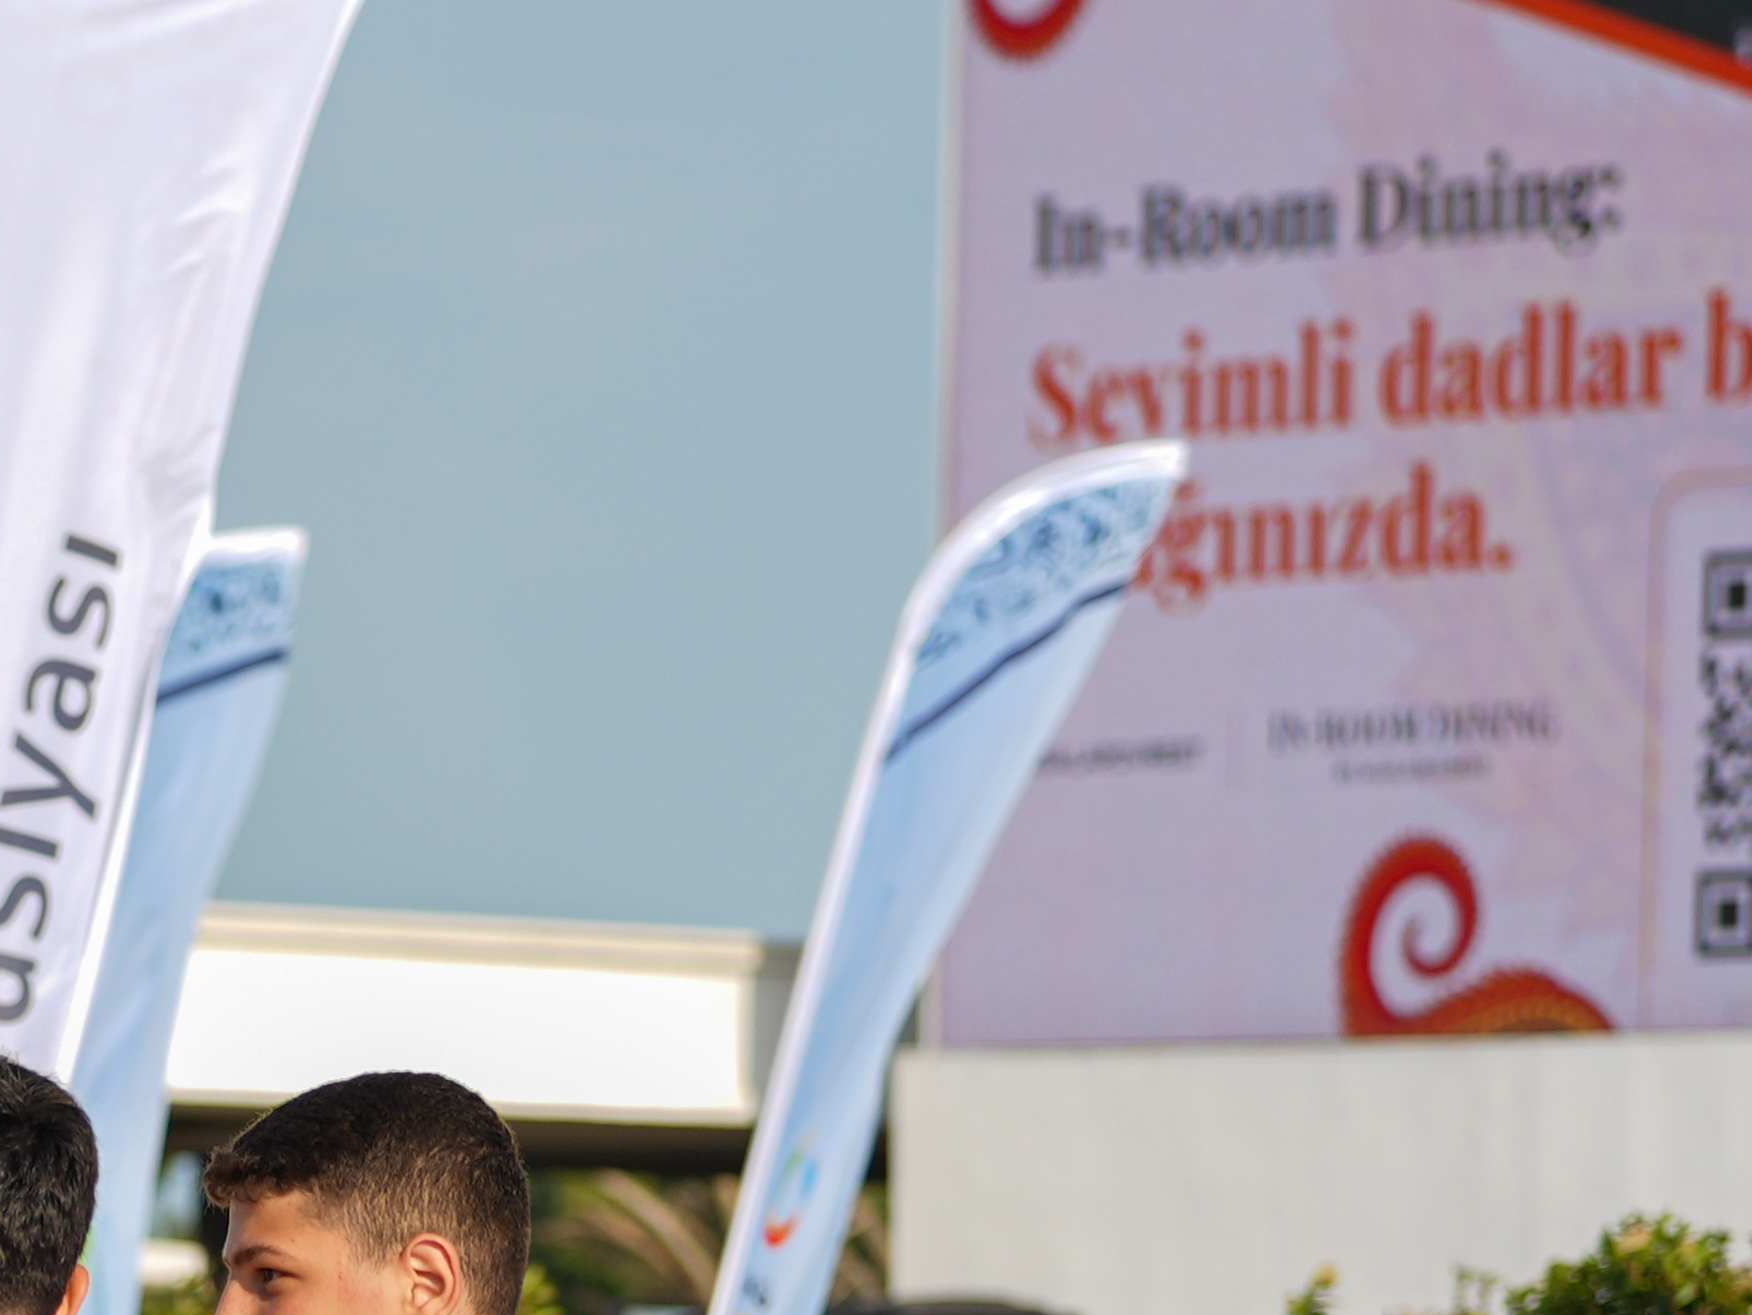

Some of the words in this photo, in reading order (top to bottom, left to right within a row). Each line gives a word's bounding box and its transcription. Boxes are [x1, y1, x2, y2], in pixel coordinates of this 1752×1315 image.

[1034, 184, 1337, 276] In-Room
[1356, 146, 1624, 255] Dining:
[1378, 302, 1682, 426] dadlar
